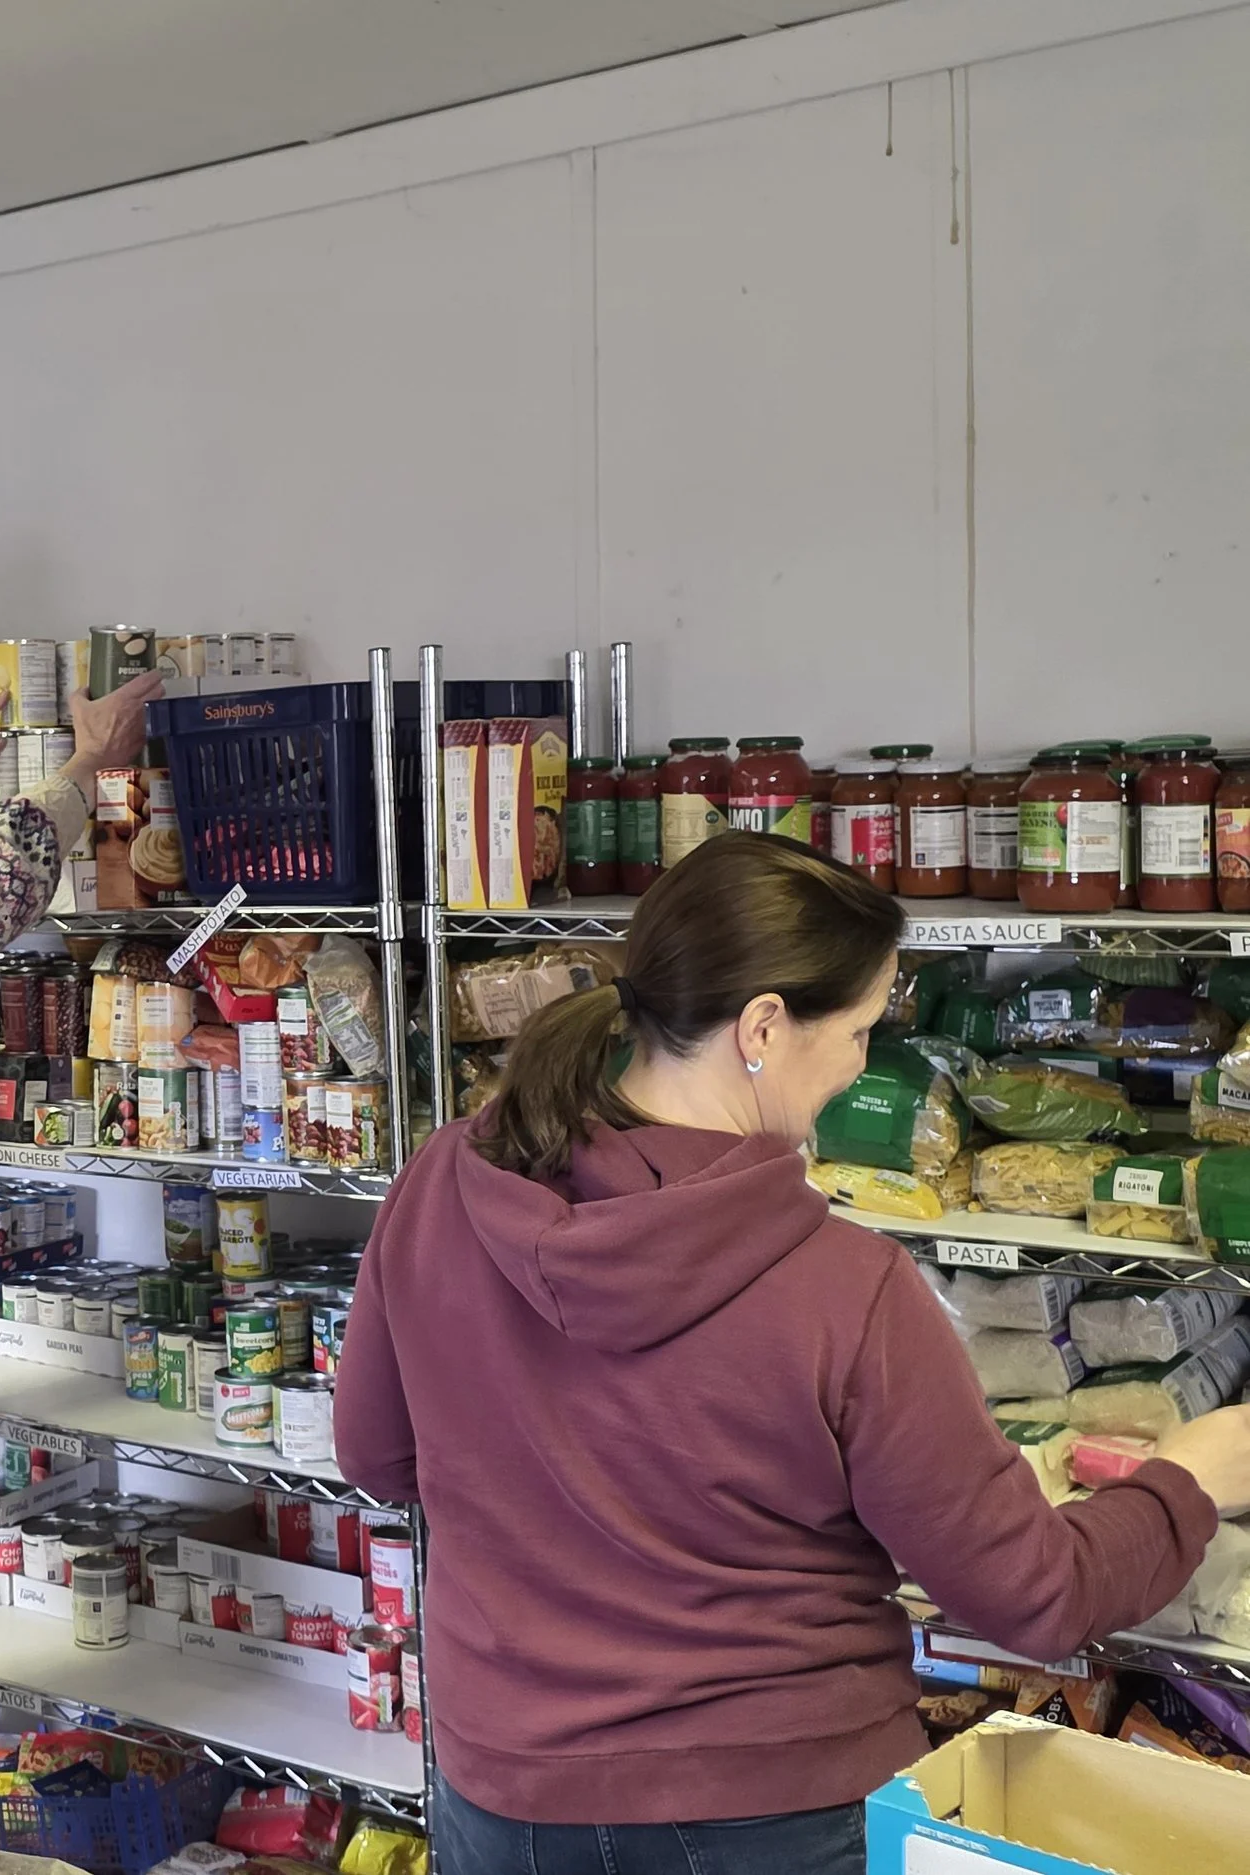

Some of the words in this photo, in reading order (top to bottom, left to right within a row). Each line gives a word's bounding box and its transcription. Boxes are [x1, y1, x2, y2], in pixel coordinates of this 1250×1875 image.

[204, 702, 275, 721] Sainsbury's
[171, 934, 202, 970] MASH
[202, 889, 242, 937] POTATO
[915, 923, 975, 943] PASTA
[981, 922, 1048, 943] SAUCE
[19, 1151, 61, 1168] CHEESE
[216, 1173, 297, 1187] VEGETARIAN
[1118, 1180, 1154, 1192] RIGATONI
[947, 1245, 1010, 1267] PASTA
[46, 1338, 69, 1352] GARDEN
[68, 1342, 83, 1355] PEAS
[235, 1335, 275, 1346] Sweetcorn
[7, 1424, 78, 1455] VEGETABLES
[239, 1642, 269, 1661] CHOPPED
[269, 1649, 305, 1668] TOMATOES
